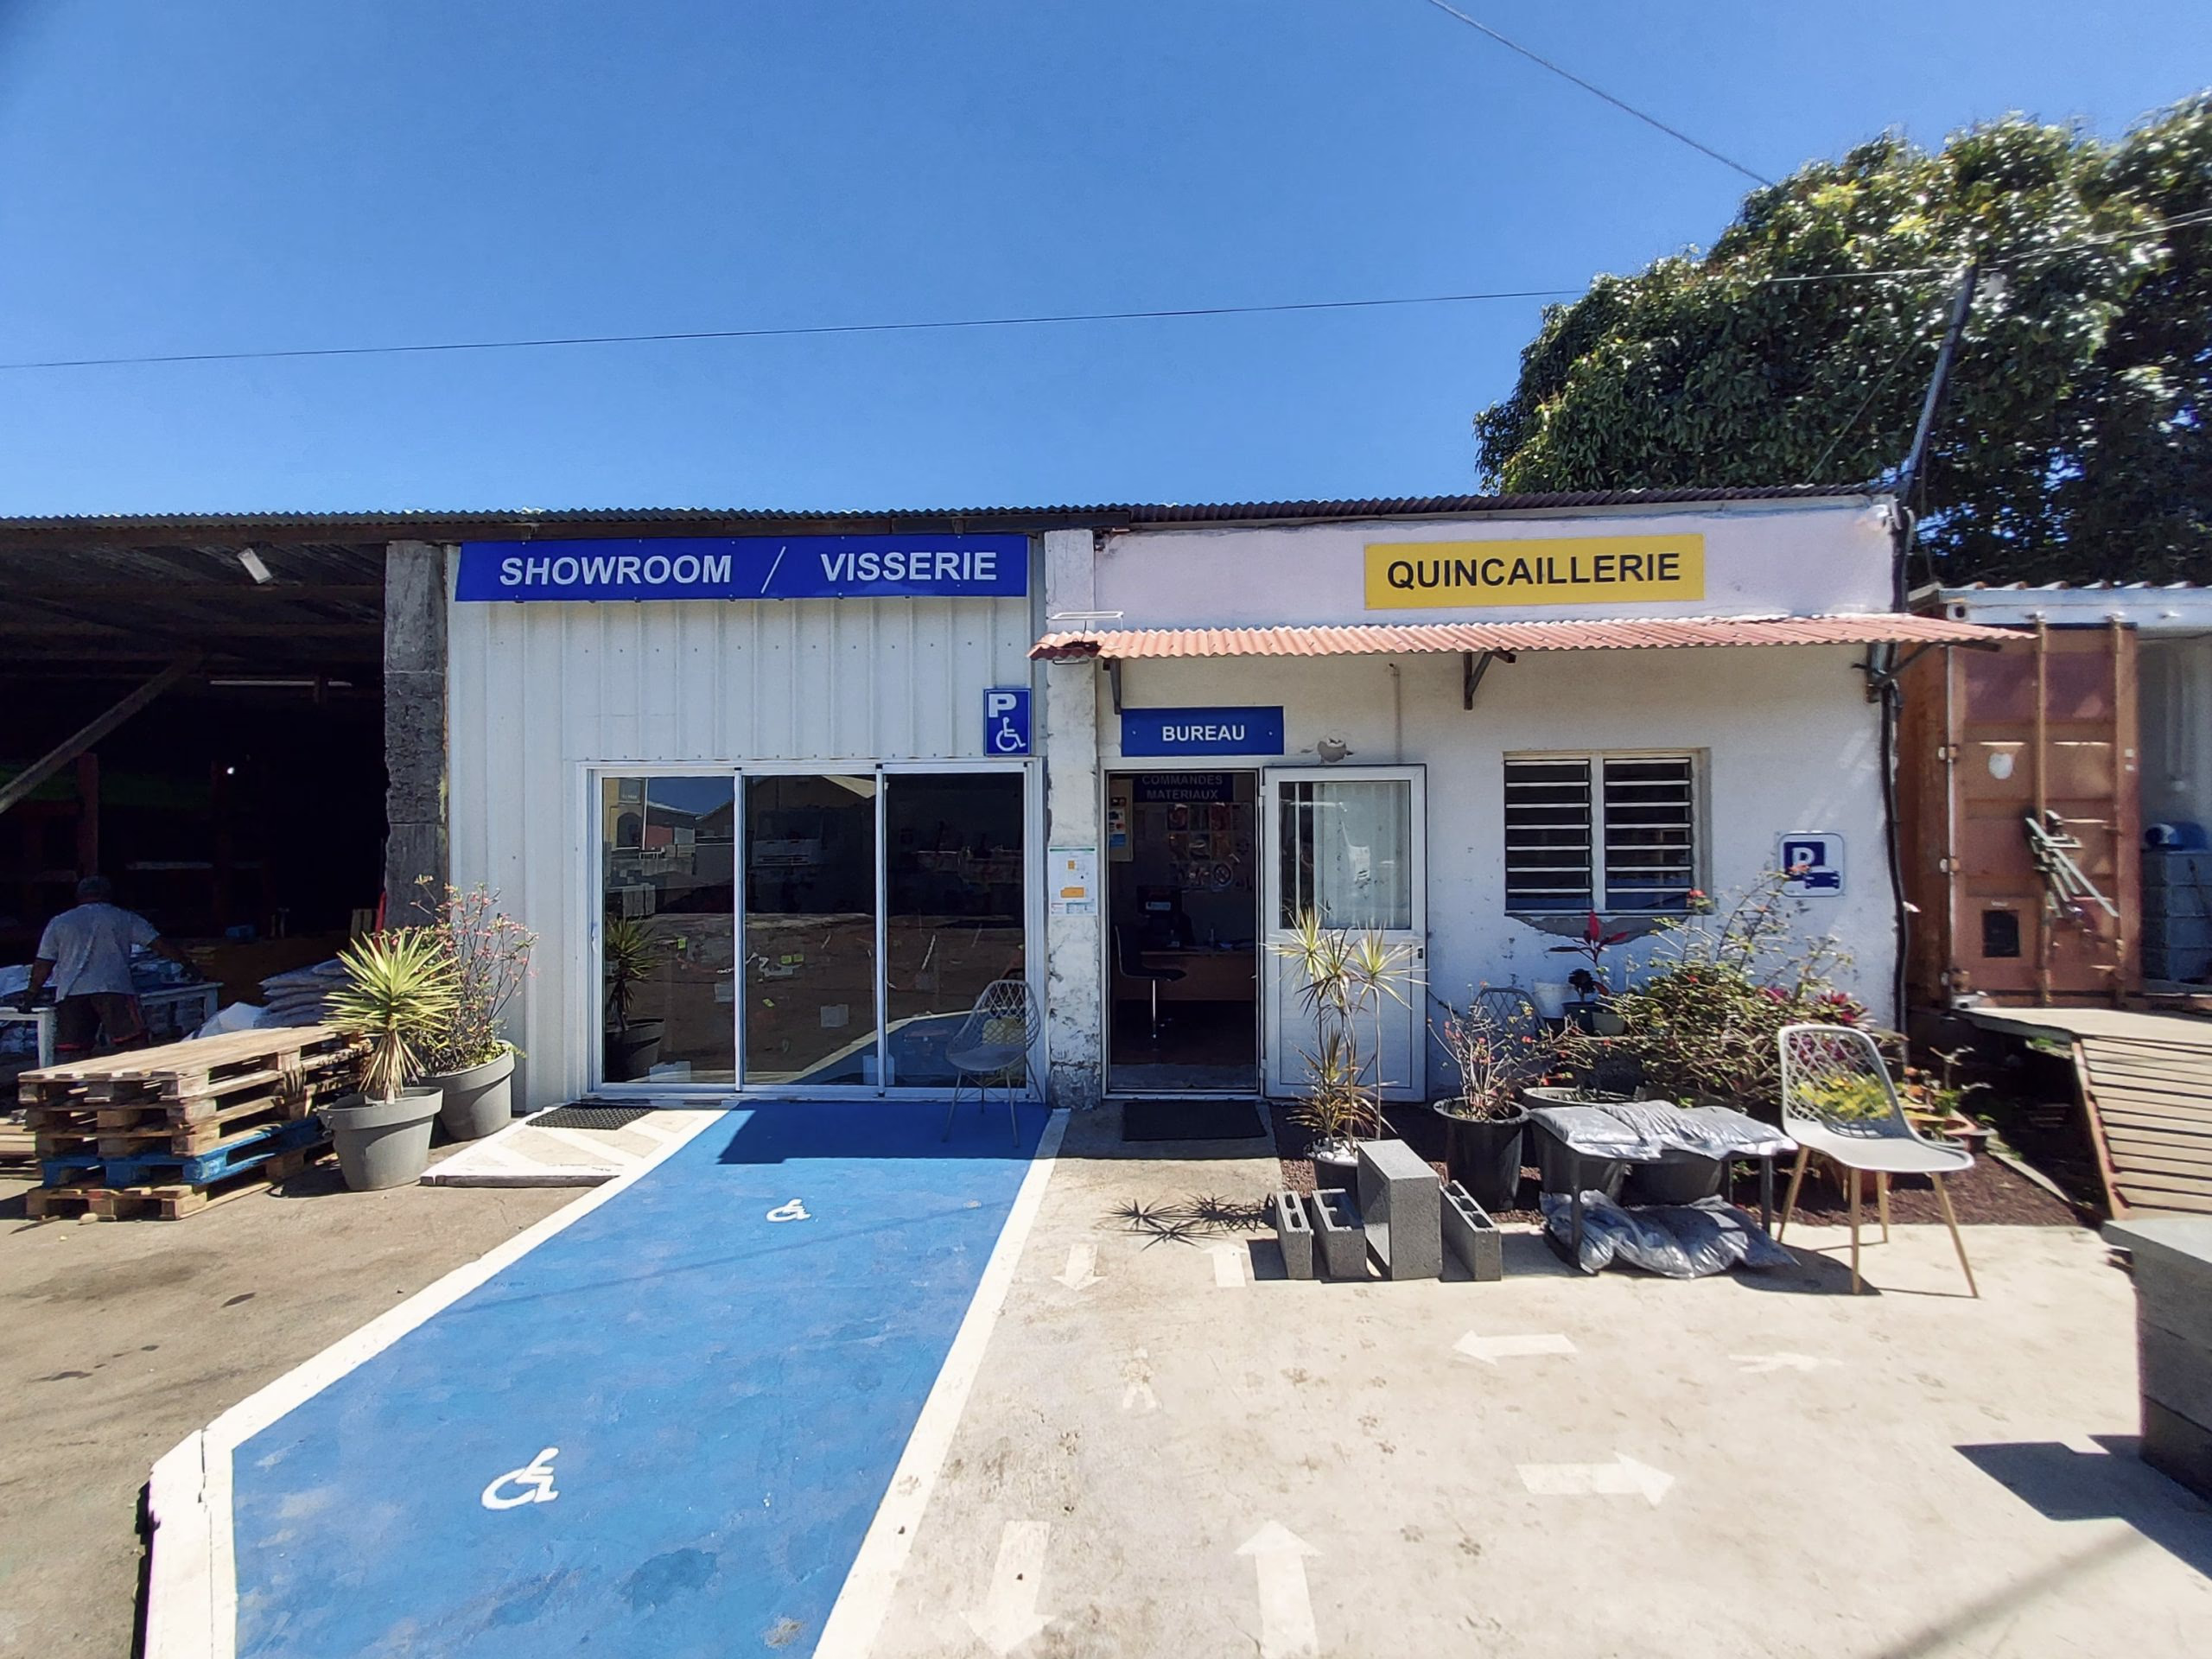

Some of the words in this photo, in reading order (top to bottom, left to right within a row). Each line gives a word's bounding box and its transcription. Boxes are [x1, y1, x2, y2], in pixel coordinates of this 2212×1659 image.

[499, 555, 732, 586] SHOWROOM
[760, 546, 786, 594] /
[820, 551, 997, 582] VISSERIE
[1387, 552, 1681, 590] QUINCAILLERIE
[988, 693, 1017, 718] P
[1161, 724, 1246, 742] BUREAU
[1141, 773, 1224, 785] COMMANDES
[1147, 789, 1219, 800] MATERIAUX
[1791, 847, 1815, 871] P
